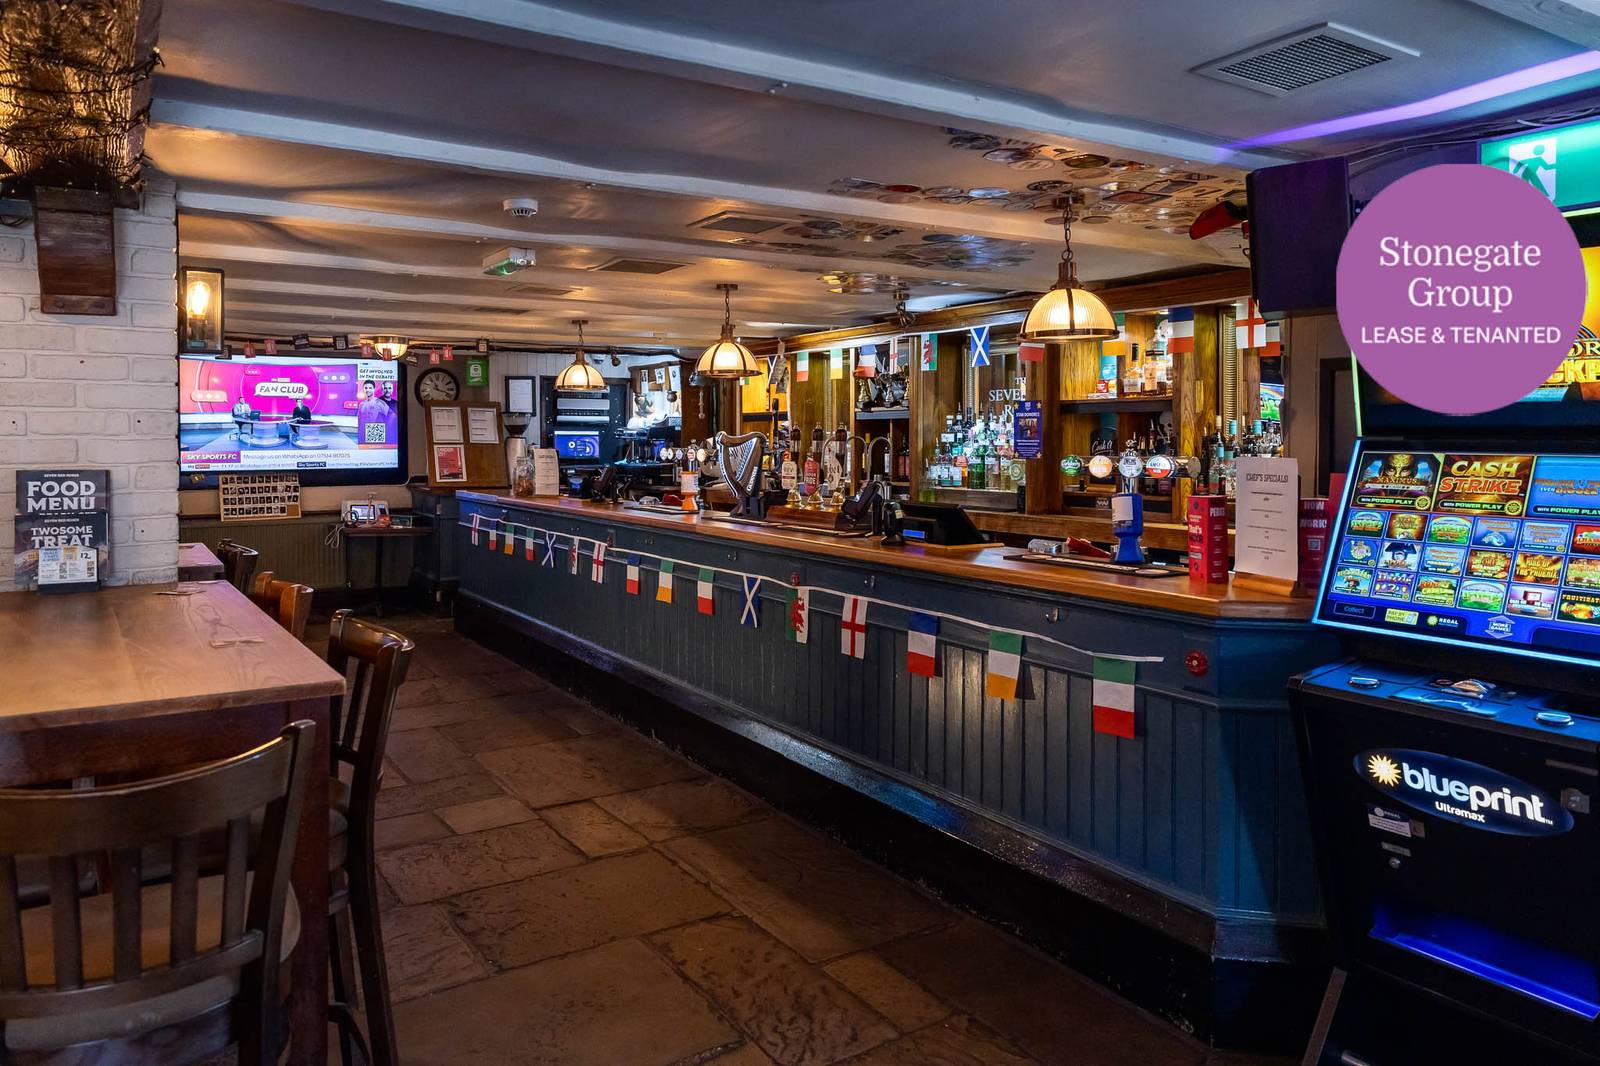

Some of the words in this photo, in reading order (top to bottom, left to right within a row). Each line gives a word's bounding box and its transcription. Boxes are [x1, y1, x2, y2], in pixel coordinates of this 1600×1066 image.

[280, 386, 304, 394] CLUB
[989, 389, 1025, 401] SEVE
[1451, 460, 1521, 478] CASH
[27, 481, 96, 496] FOOD
[1439, 477, 1522, 496] STRIKE
[27, 497, 96, 512] MENU
[1303, 501, 1325, 510] HOW
[31, 526, 93, 535] TWOSOME
[31, 535, 93, 549] TREAT
[1562, 594, 1600, 604] FRUITINAT
[1401, 763, 1545, 823] blueprint
[1434, 801, 1485, 822] Ultramax
